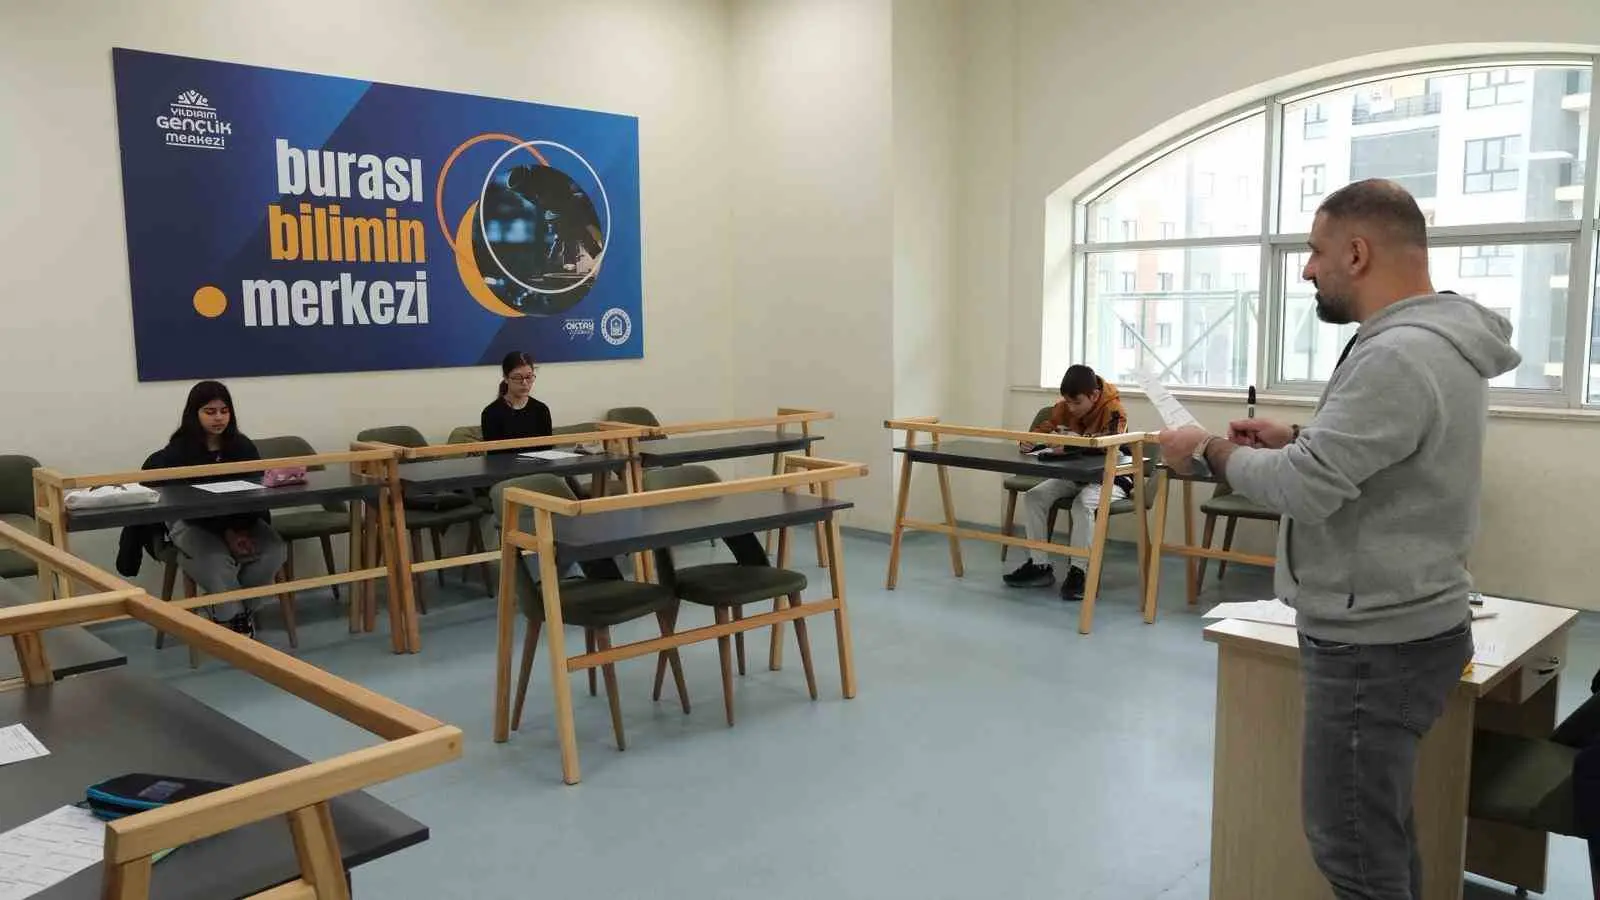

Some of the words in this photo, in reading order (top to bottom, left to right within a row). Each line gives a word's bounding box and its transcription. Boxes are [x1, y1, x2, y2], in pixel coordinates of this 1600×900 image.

[275, 138, 424, 202] burası
[268, 203, 426, 264] bilimin
[241, 270, 429, 327] merkezi
